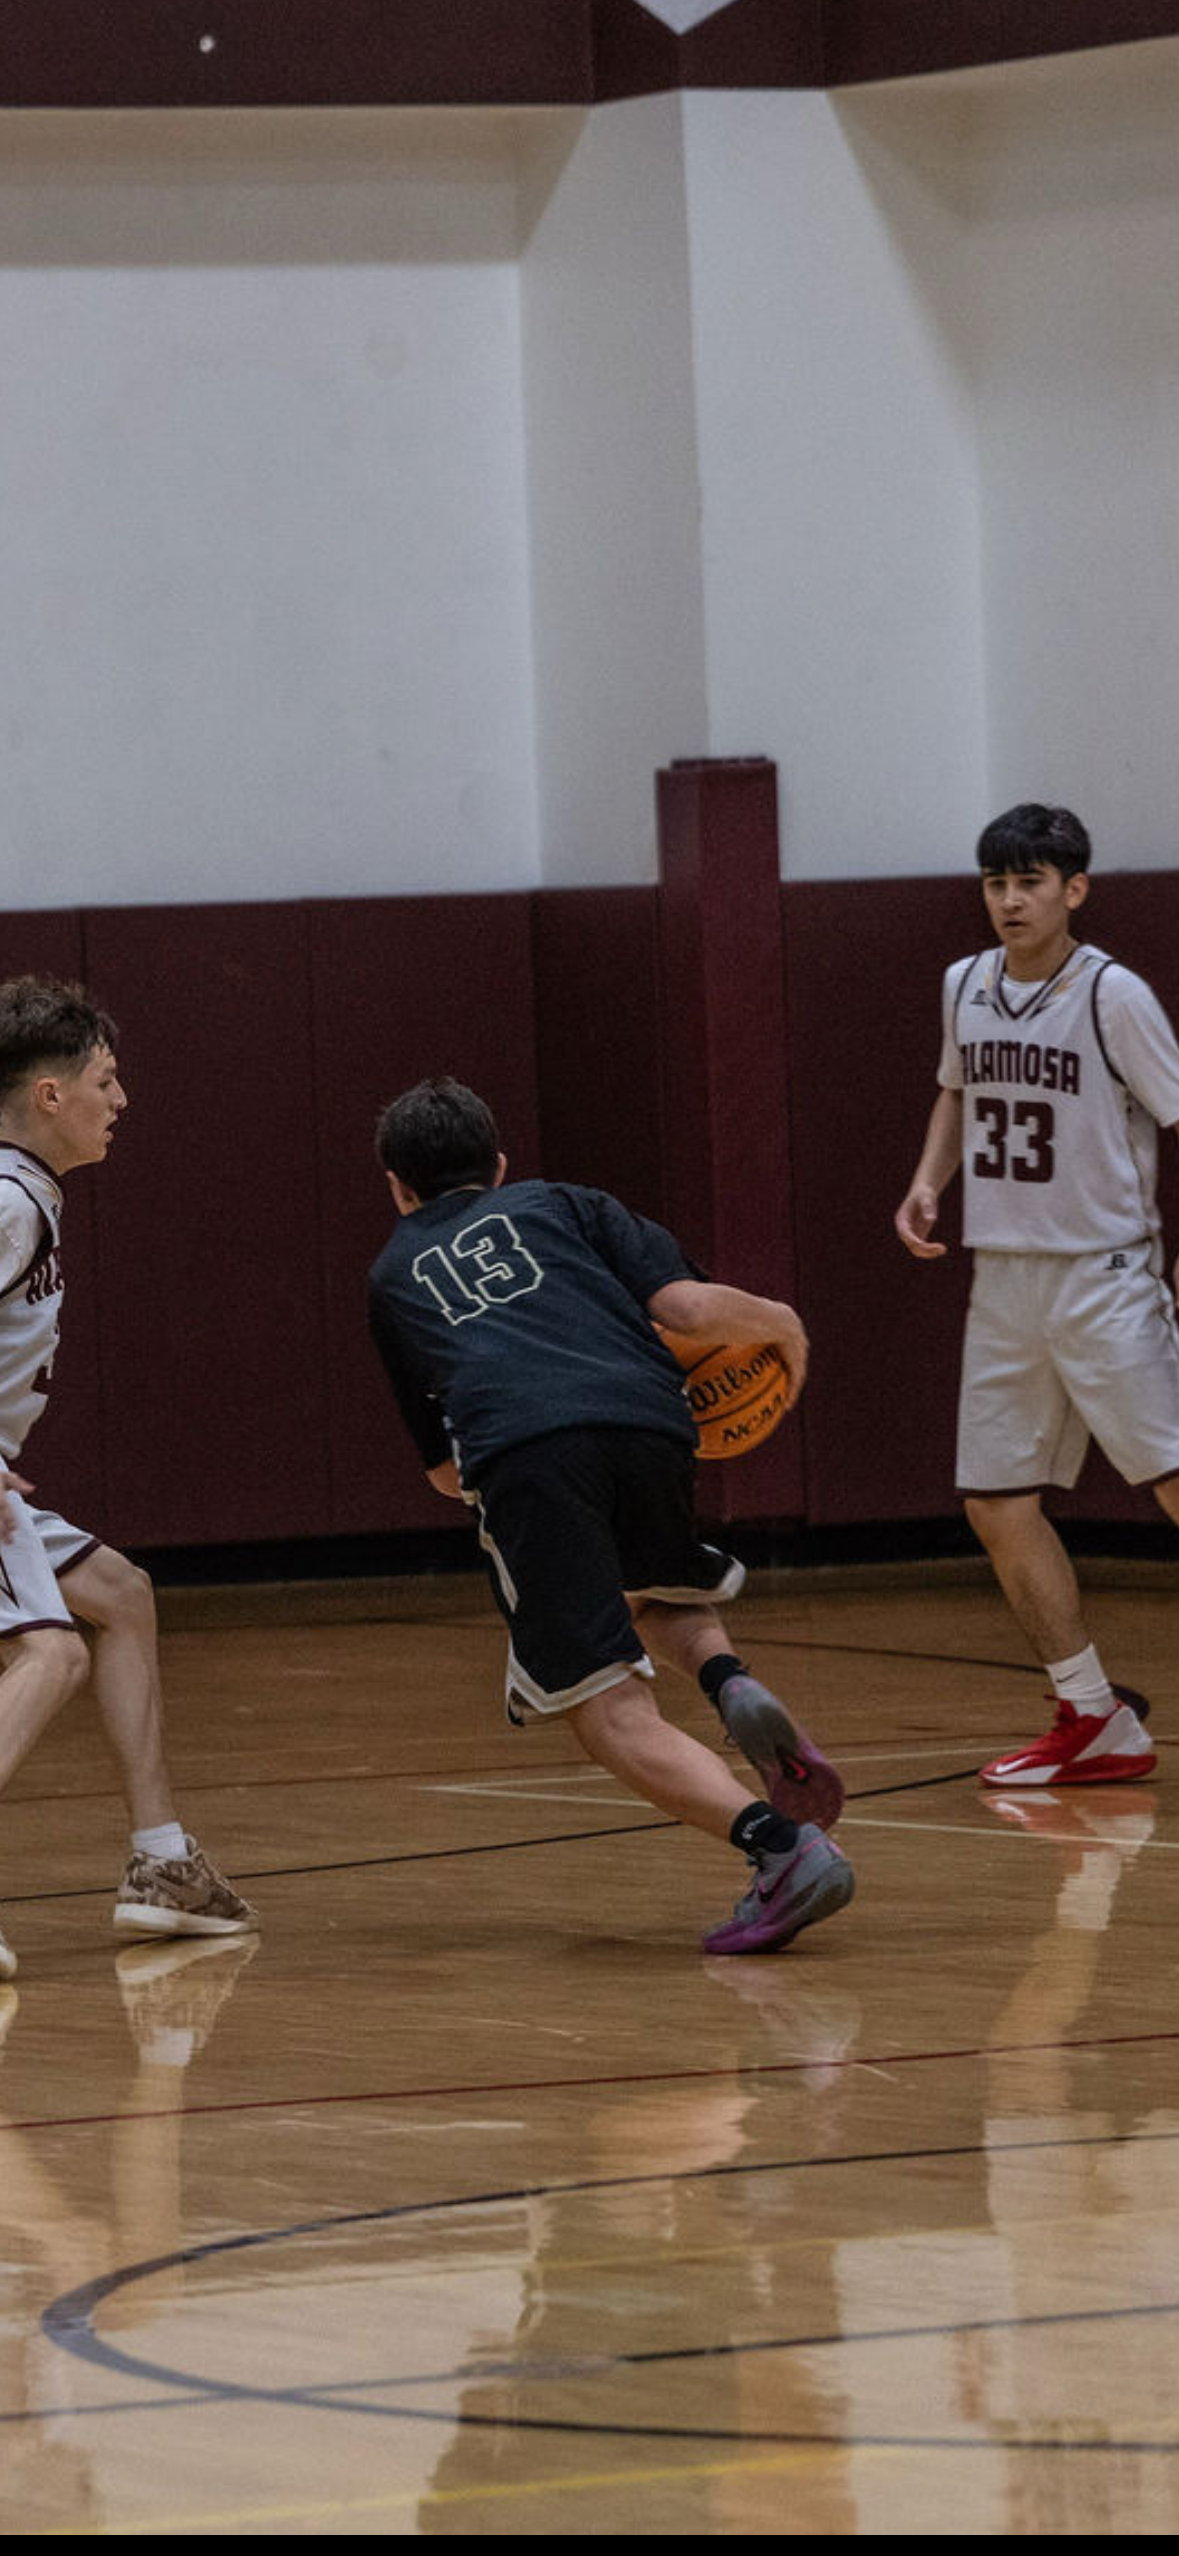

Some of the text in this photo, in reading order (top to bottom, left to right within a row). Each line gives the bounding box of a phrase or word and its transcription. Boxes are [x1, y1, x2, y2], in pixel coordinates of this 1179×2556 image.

[974, 1097, 1054, 1183] 33
[412, 1213, 544, 1326] 13
[688, 1346, 778, 1412] Wilson
